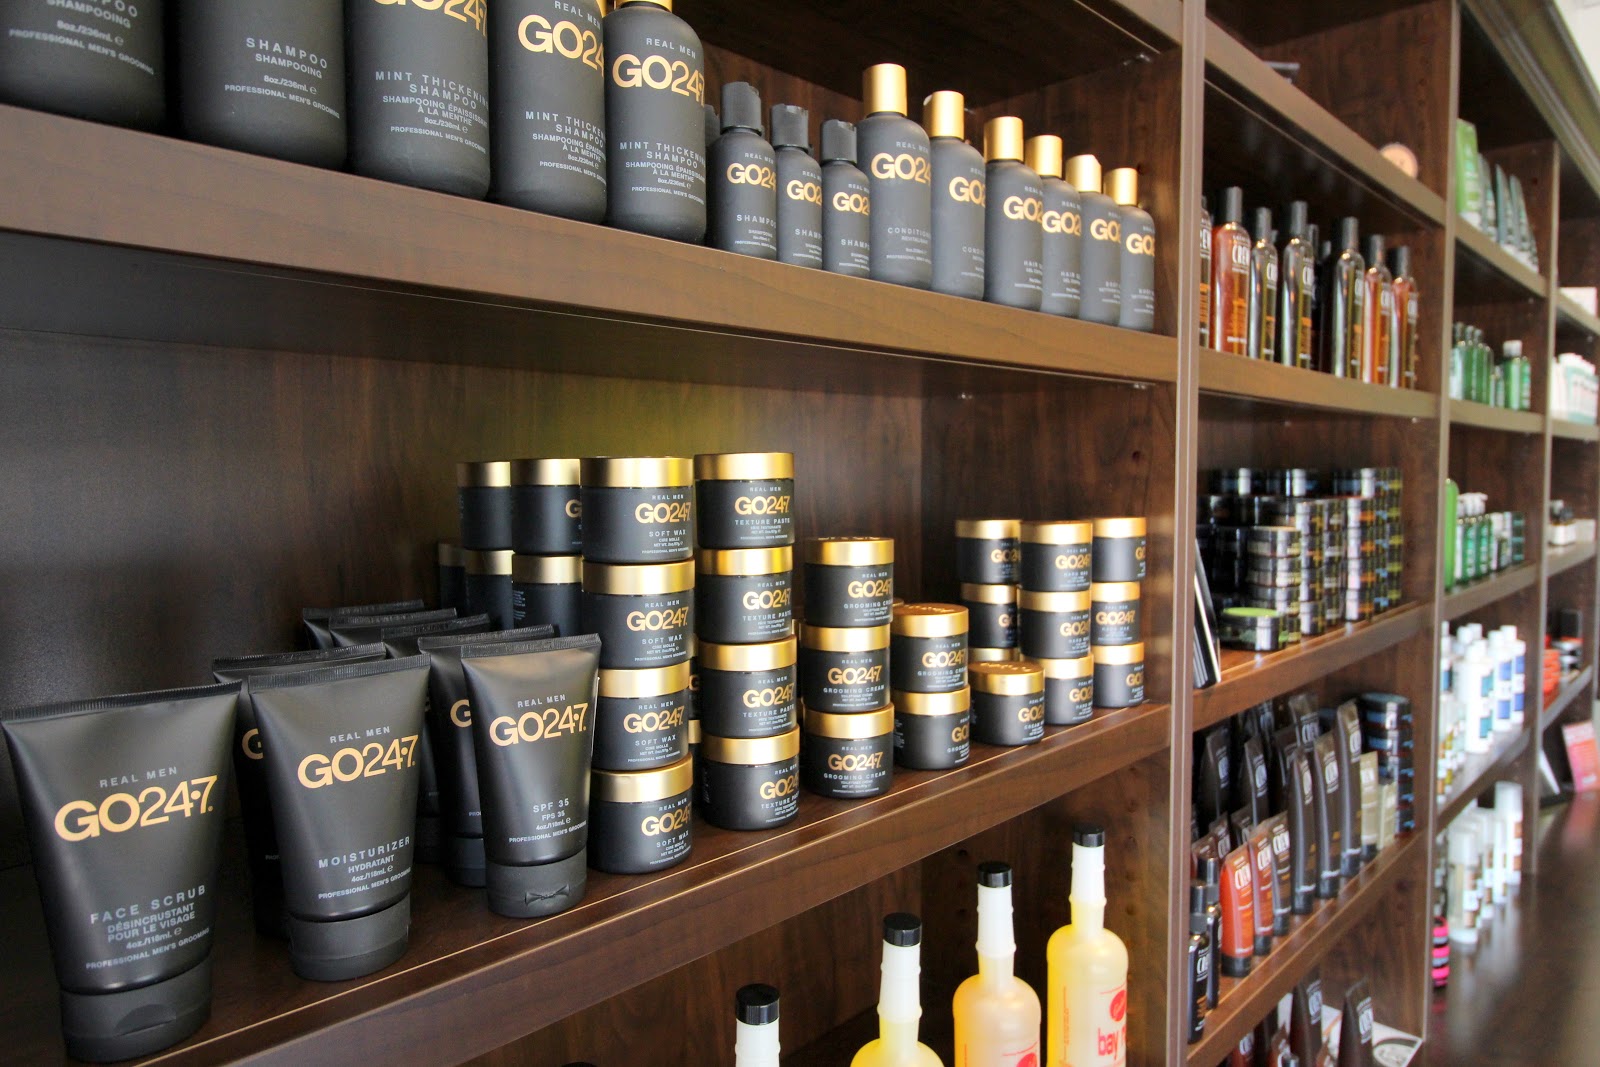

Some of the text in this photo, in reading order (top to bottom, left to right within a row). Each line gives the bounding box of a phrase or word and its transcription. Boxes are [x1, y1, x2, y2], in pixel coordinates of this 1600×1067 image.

[554, 0, 583, 18] REAL
[9, 28, 85, 49] PROFESSIONAL
[246, 37, 327, 70] SHAMPOO
[646, 37, 696, 59] REAL MEN
[255, 53, 322, 79] SHAMPOOING
[375, 71, 412, 82] MINT
[224, 84, 286, 99] PROFESSIONAL
[289, 93, 311, 105] MEN'S
[409, 84, 476, 109] SHAMPOO
[382, 95, 446, 110] SHAMPOOING
[427, 108, 439, 116] LA
[442, 111, 472, 126] MENTHE
[525, 111, 558, 122] MINT
[390, 126, 443, 138] PROFESSIONAL
[532, 133, 583, 149] SHAMPOOING
[619, 141, 649, 151] MINT
[896, 141, 917, 150] REAL
[570, 145, 579, 154] LA
[745, 152, 762, 161] REAL
[539, 160, 583, 174] PROFESSIONAL
[625, 161, 675, 172] SHAMPOOING
[646, 151, 698, 169] SHAMPOO
[660, 169, 669, 177] LA
[631, 186, 672, 196] PROFESSIONAL
[735, 518, 770, 526] TEXTURE
[649, 530, 671, 538] SOFT
[742, 613, 775, 621] TEXTURE
[642, 633, 683, 645] SOFT WAX
[517, 694, 566, 709] REAL MEN
[742, 710, 777, 718] TEXTURE
[330, 726, 390, 744] REAL MEN
[635, 734, 677, 747] SOFT WAX
[100, 766, 178, 788] REAL MEN
[865, 770, 886, 779] CREAM
[533, 798, 569, 813] SPF 35
[760, 797, 790, 809] TEXTURE
[542, 810, 565, 822] FPS 35
[508, 833, 552, 843] PROFESSIONAL
[656, 838, 675, 848] SOFT
[318, 836, 410, 869] MOISTURIZER
[348, 854, 395, 874] HYDRATANT
[318, 885, 370, 899] PROFESSIONAL
[371, 878, 389, 889] MEN'S
[90, 885, 205, 924] FACE SCRUB
[108, 903, 195, 933] DÉSINCRUSTANT
[108, 911, 196, 943] POUR LE VISAGE
[86, 951, 150, 969] PROFESSIONAL
[152, 942, 176, 957] MEN'S
[1097, 1027, 1119, 1061] bay
